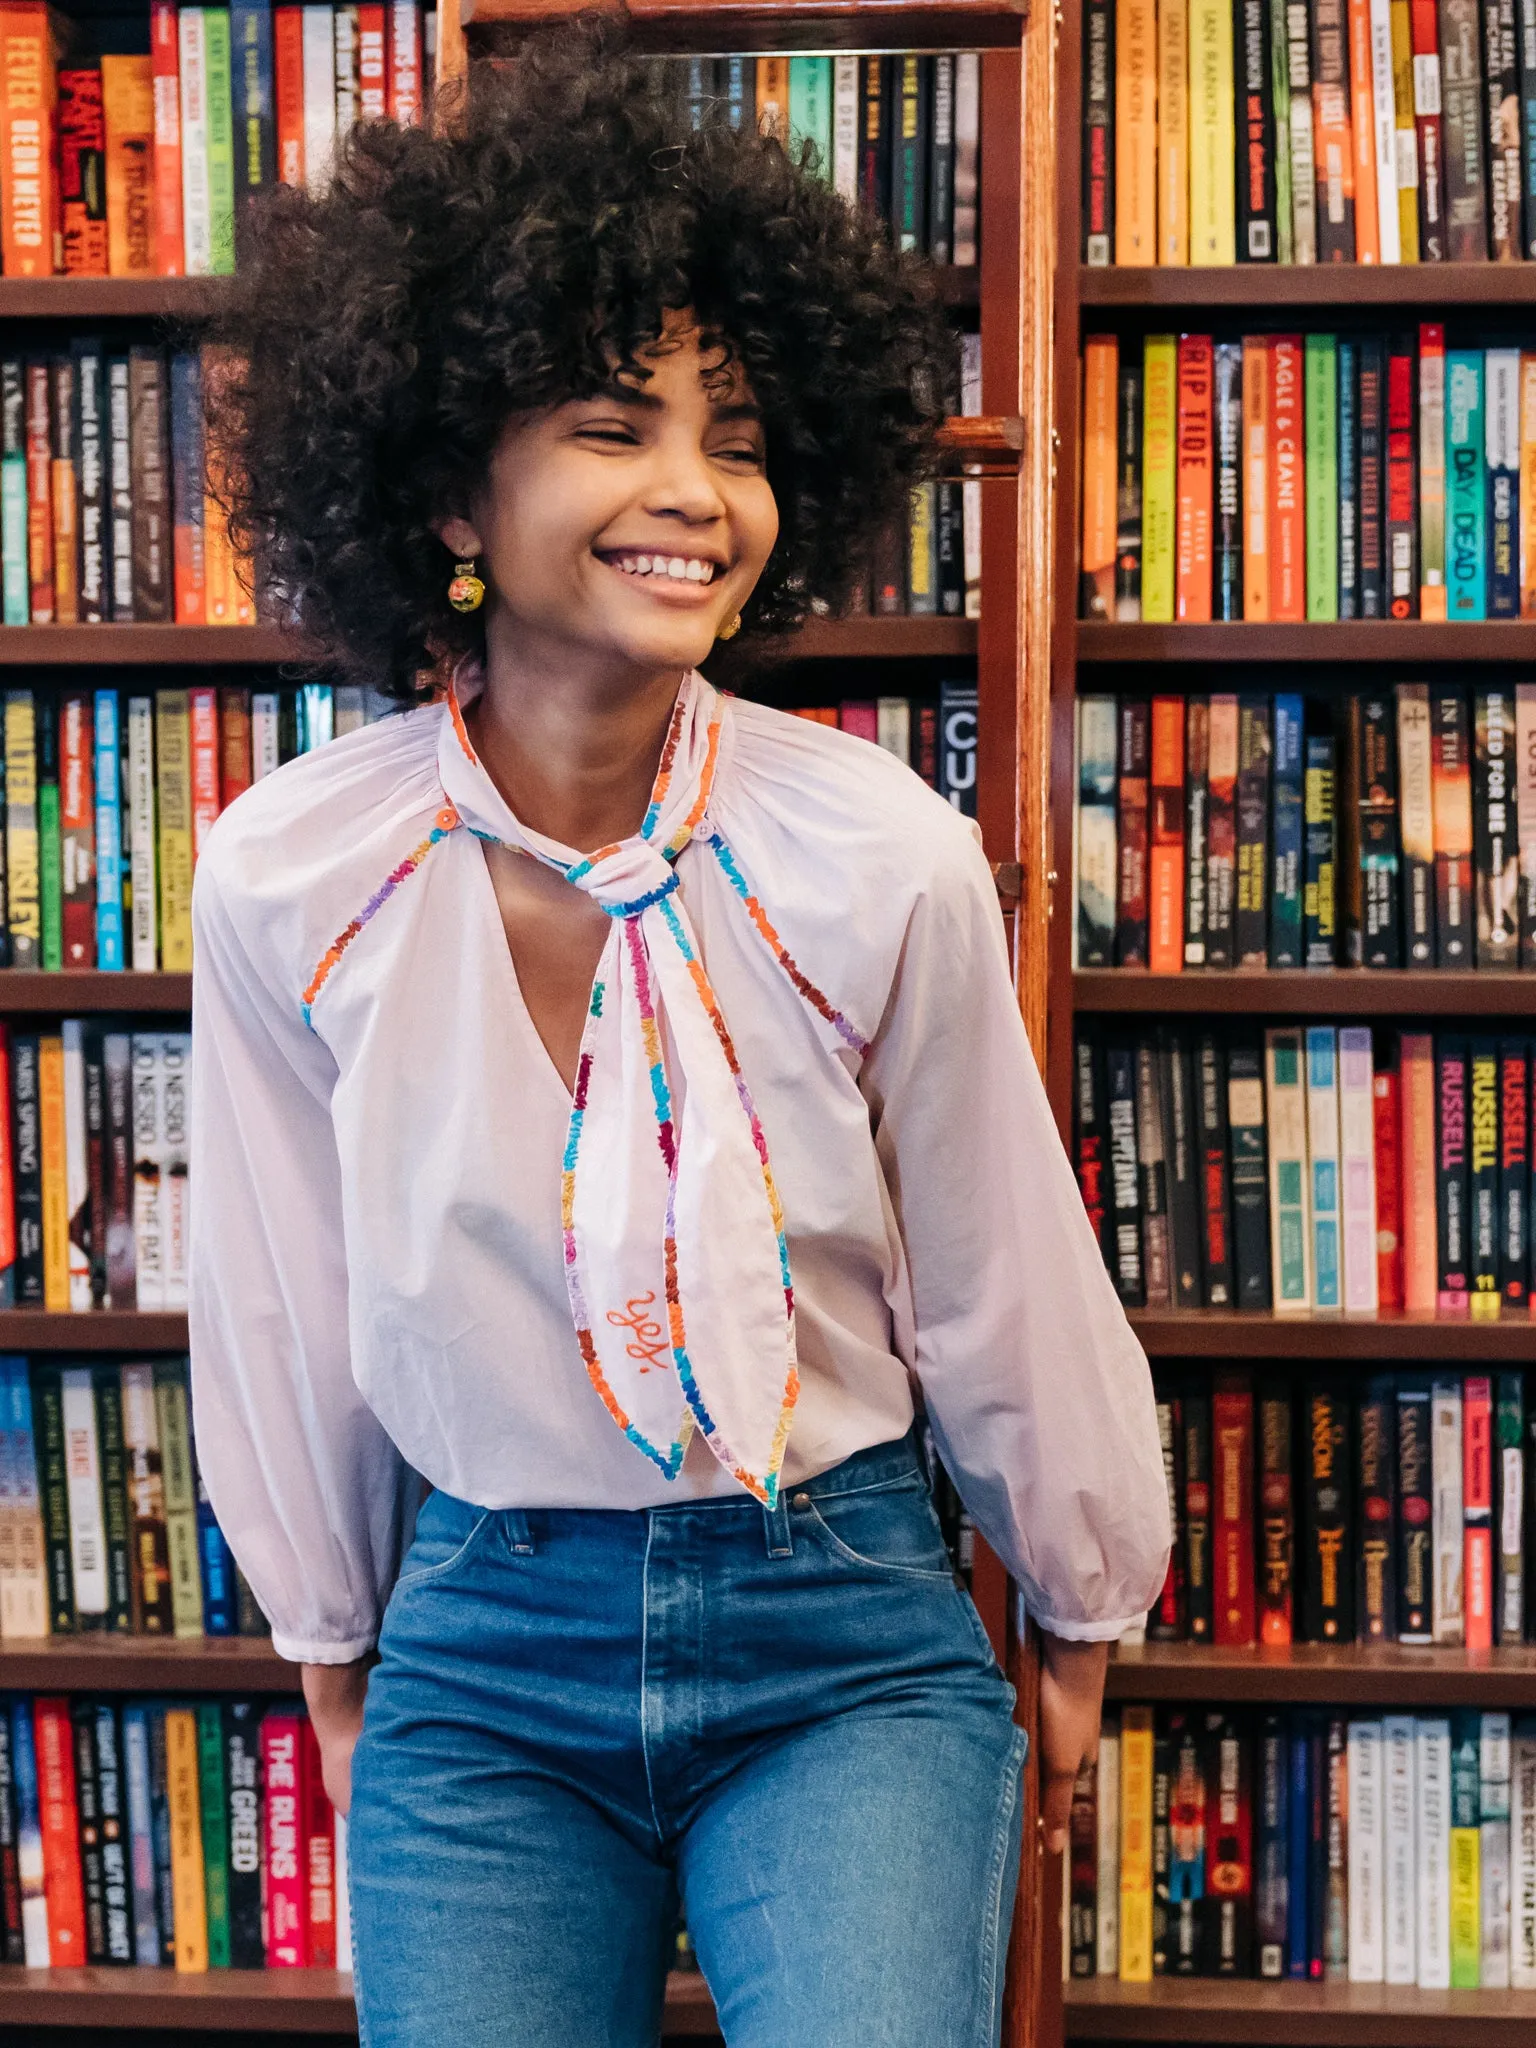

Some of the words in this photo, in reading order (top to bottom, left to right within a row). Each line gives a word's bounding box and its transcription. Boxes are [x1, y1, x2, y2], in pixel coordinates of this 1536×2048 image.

[1129, 6, 1145, 41] IAN
[1166, 12, 1182, 48] IAN
[1203, 10, 1218, 44] IAN
[1486, 6, 1503, 77] MICHAEL
[7, 36, 42, 110] FEVER
[1129, 47, 1145, 125] RANKIN
[1203, 50, 1218, 126] RANKIN
[1245, 30, 1262, 91] RANKIN
[1166, 54, 1182, 135] RANKIN
[11, 119, 40, 176] DEON
[838, 104, 853, 152] DROP
[12, 179, 42, 247] MEYER
[123, 165, 147, 270] TRACKERS
[1181, 348, 1209, 398] RIP
[1275, 341, 1296, 410] EAGLE
[1181, 409, 1207, 470] TIDE
[1276, 416, 1293, 431] &
[1219, 467, 1238, 516] ASSET
[1276, 437, 1296, 510] CRANE
[1454, 446, 1478, 497] DAY
[1494, 476, 1511, 520] DEAD
[1454, 512, 1479, 582] DEAD
[1443, 698, 1461, 724] IN
[1485, 693, 1506, 758] BLEED
[1410, 739, 1430, 833] KINDRED
[1486, 759, 1508, 800] FOR
[1487, 802, 1508, 835] ME
[1441, 1059, 1465, 1172] RUSSELL
[1472, 1061, 1497, 1174] RUSSELL
[1502, 1058, 1526, 1169] RUSSELL
[266, 1733, 295, 1789] THE
[230, 1790, 258, 1873] GREED
[268, 1795, 297, 1880] RUINS
